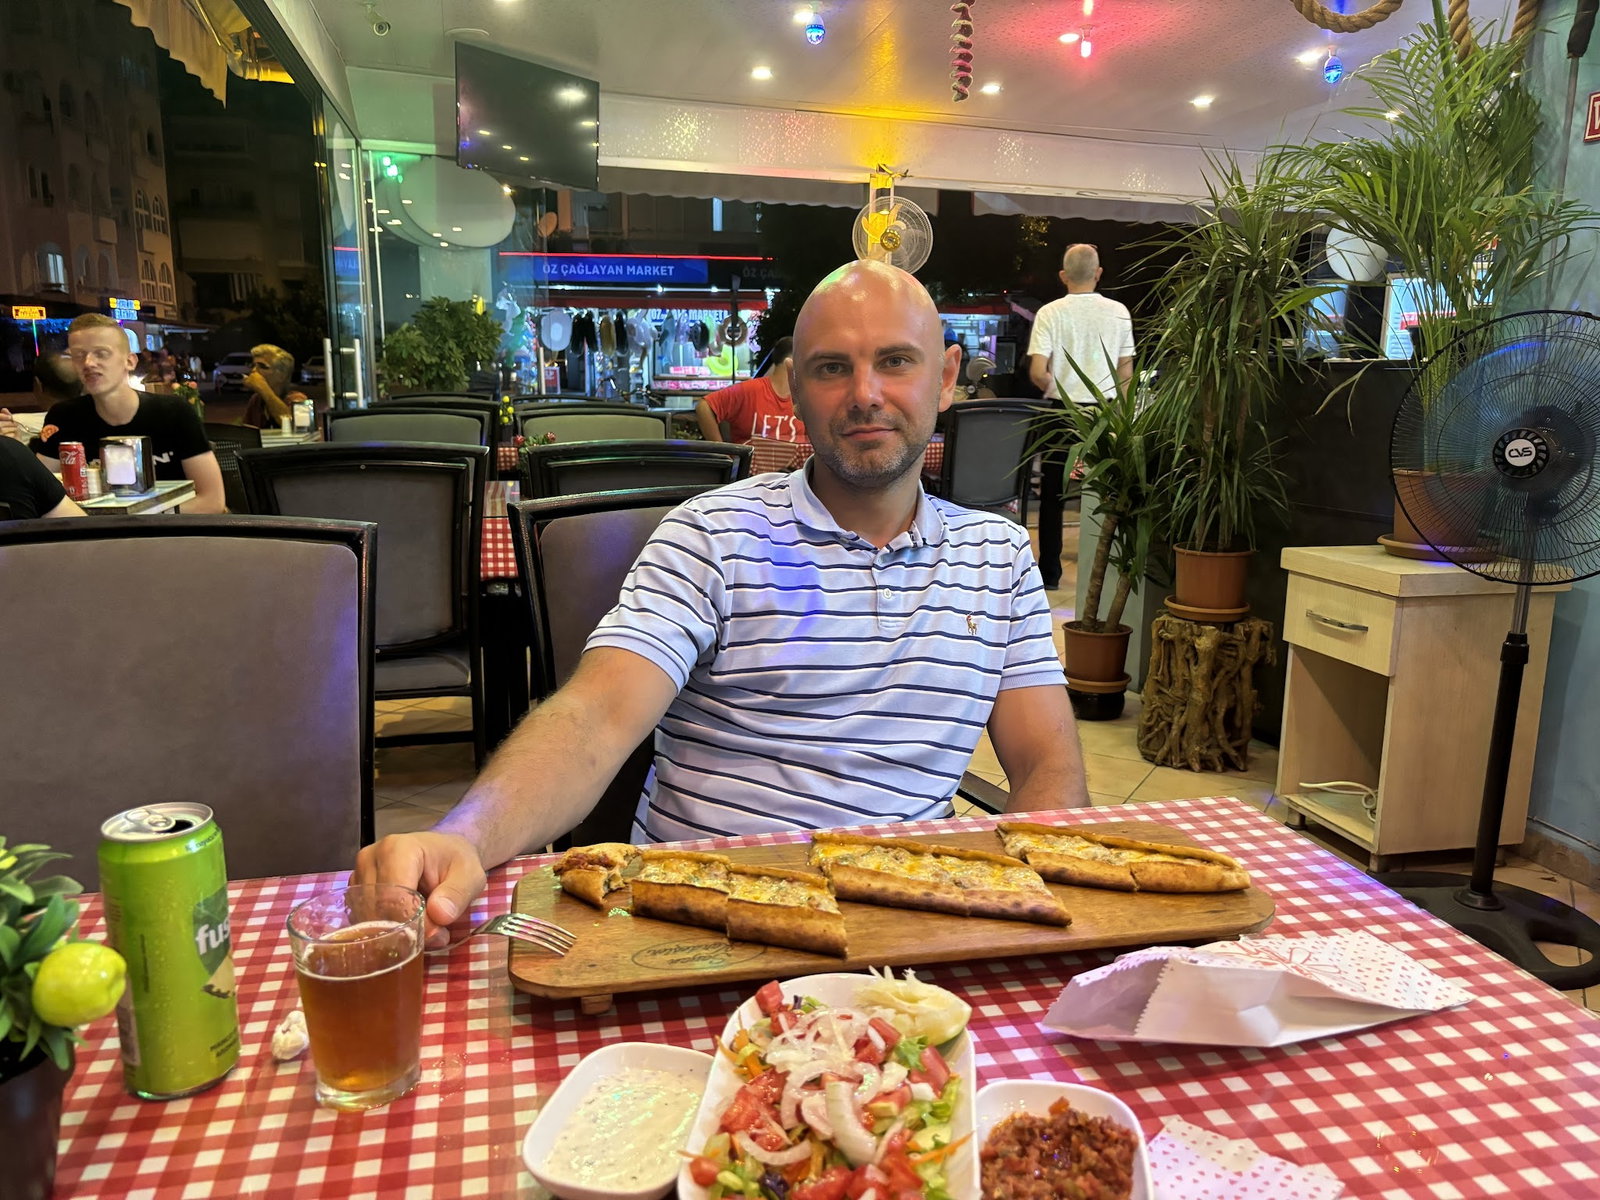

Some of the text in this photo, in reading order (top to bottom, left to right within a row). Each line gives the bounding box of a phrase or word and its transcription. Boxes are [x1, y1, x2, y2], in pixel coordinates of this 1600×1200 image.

[560, 262, 623, 277] ÇAĞLAYAN
[626, 265, 675, 276] MARKET
[751, 411, 797, 443] LET'S
[1508, 446, 1533, 458] CVS
